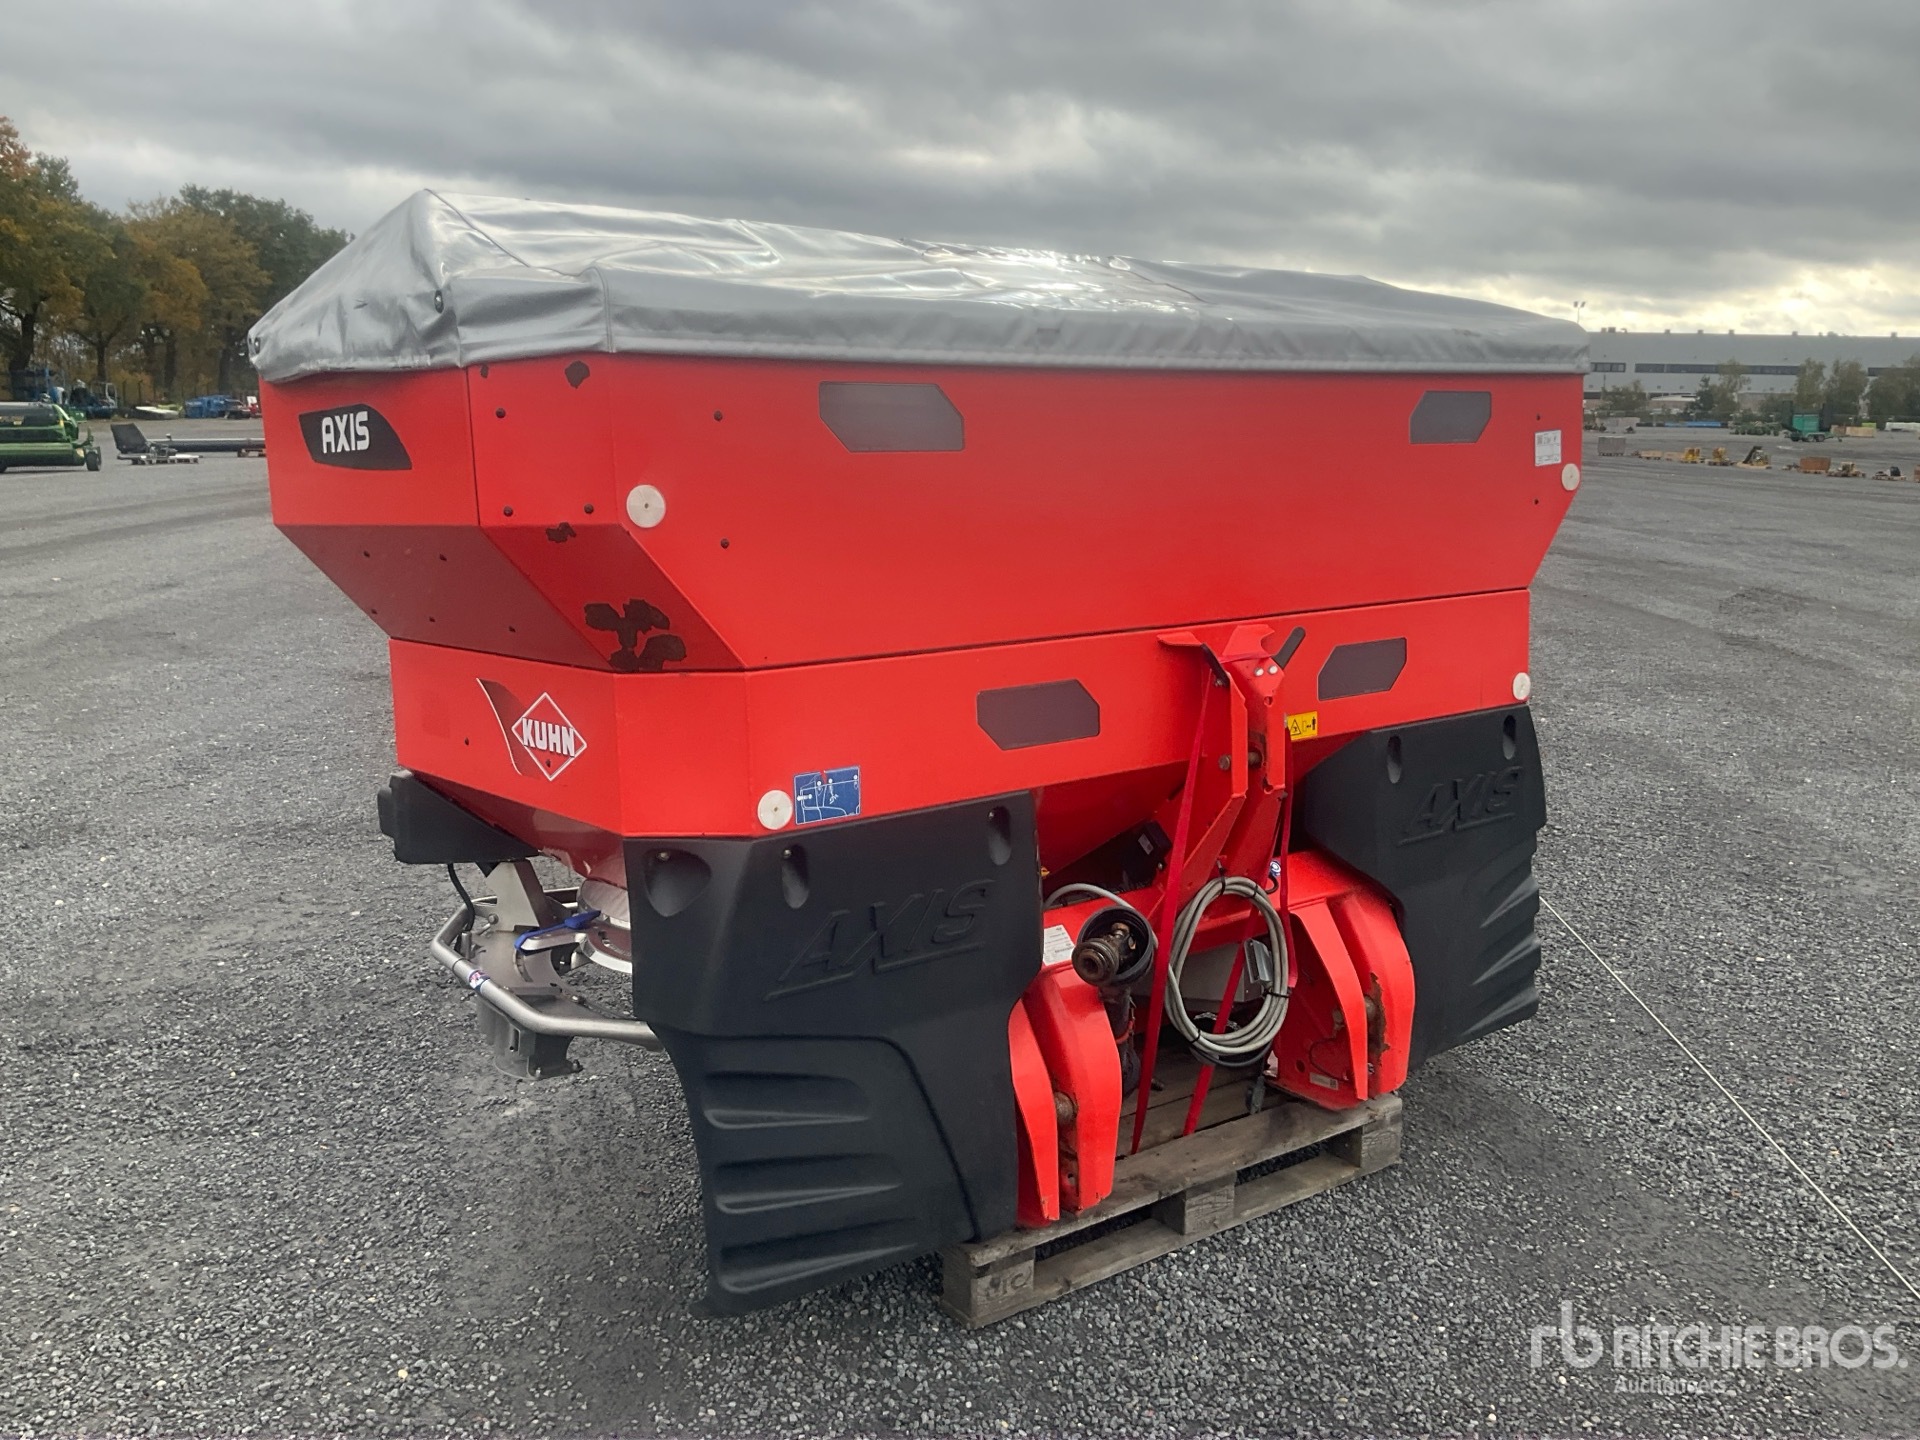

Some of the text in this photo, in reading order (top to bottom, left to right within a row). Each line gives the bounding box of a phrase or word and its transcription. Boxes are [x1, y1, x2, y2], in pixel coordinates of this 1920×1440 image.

[321, 410, 370, 454] AXIS
[521, 717, 576, 758] KUHN
[1402, 765, 1524, 840] AXIS
[767, 878, 996, 994] AXIS
